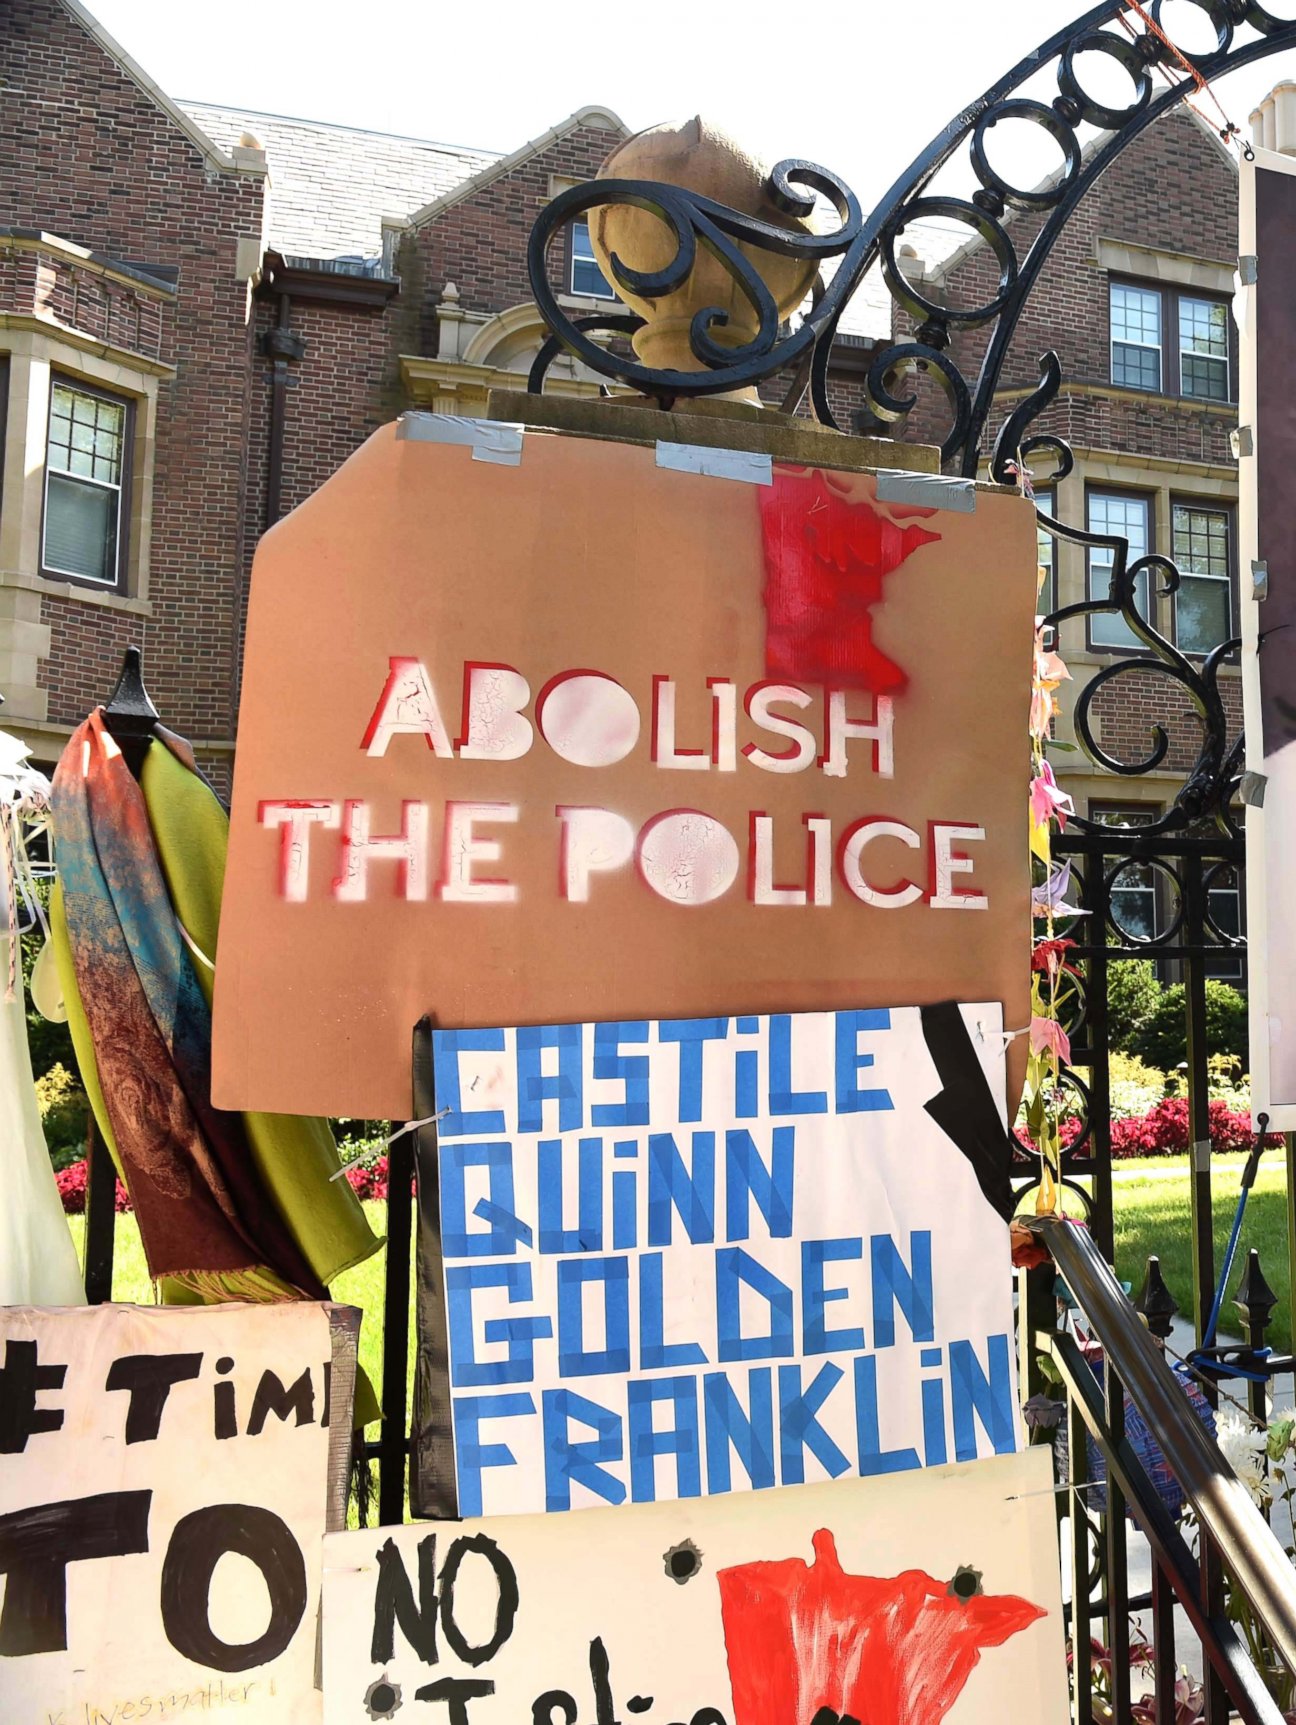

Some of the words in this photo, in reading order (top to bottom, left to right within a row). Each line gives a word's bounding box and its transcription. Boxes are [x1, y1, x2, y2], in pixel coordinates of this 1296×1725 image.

[359, 655, 895, 779] ABOLISH
[257, 799, 520, 903] THE
[554, 805, 989, 911] POLICE
[445, 1230, 935, 1388] GOLDEN
[0, 1489, 308, 1673] TO
[370, 1532, 520, 1668] NO
